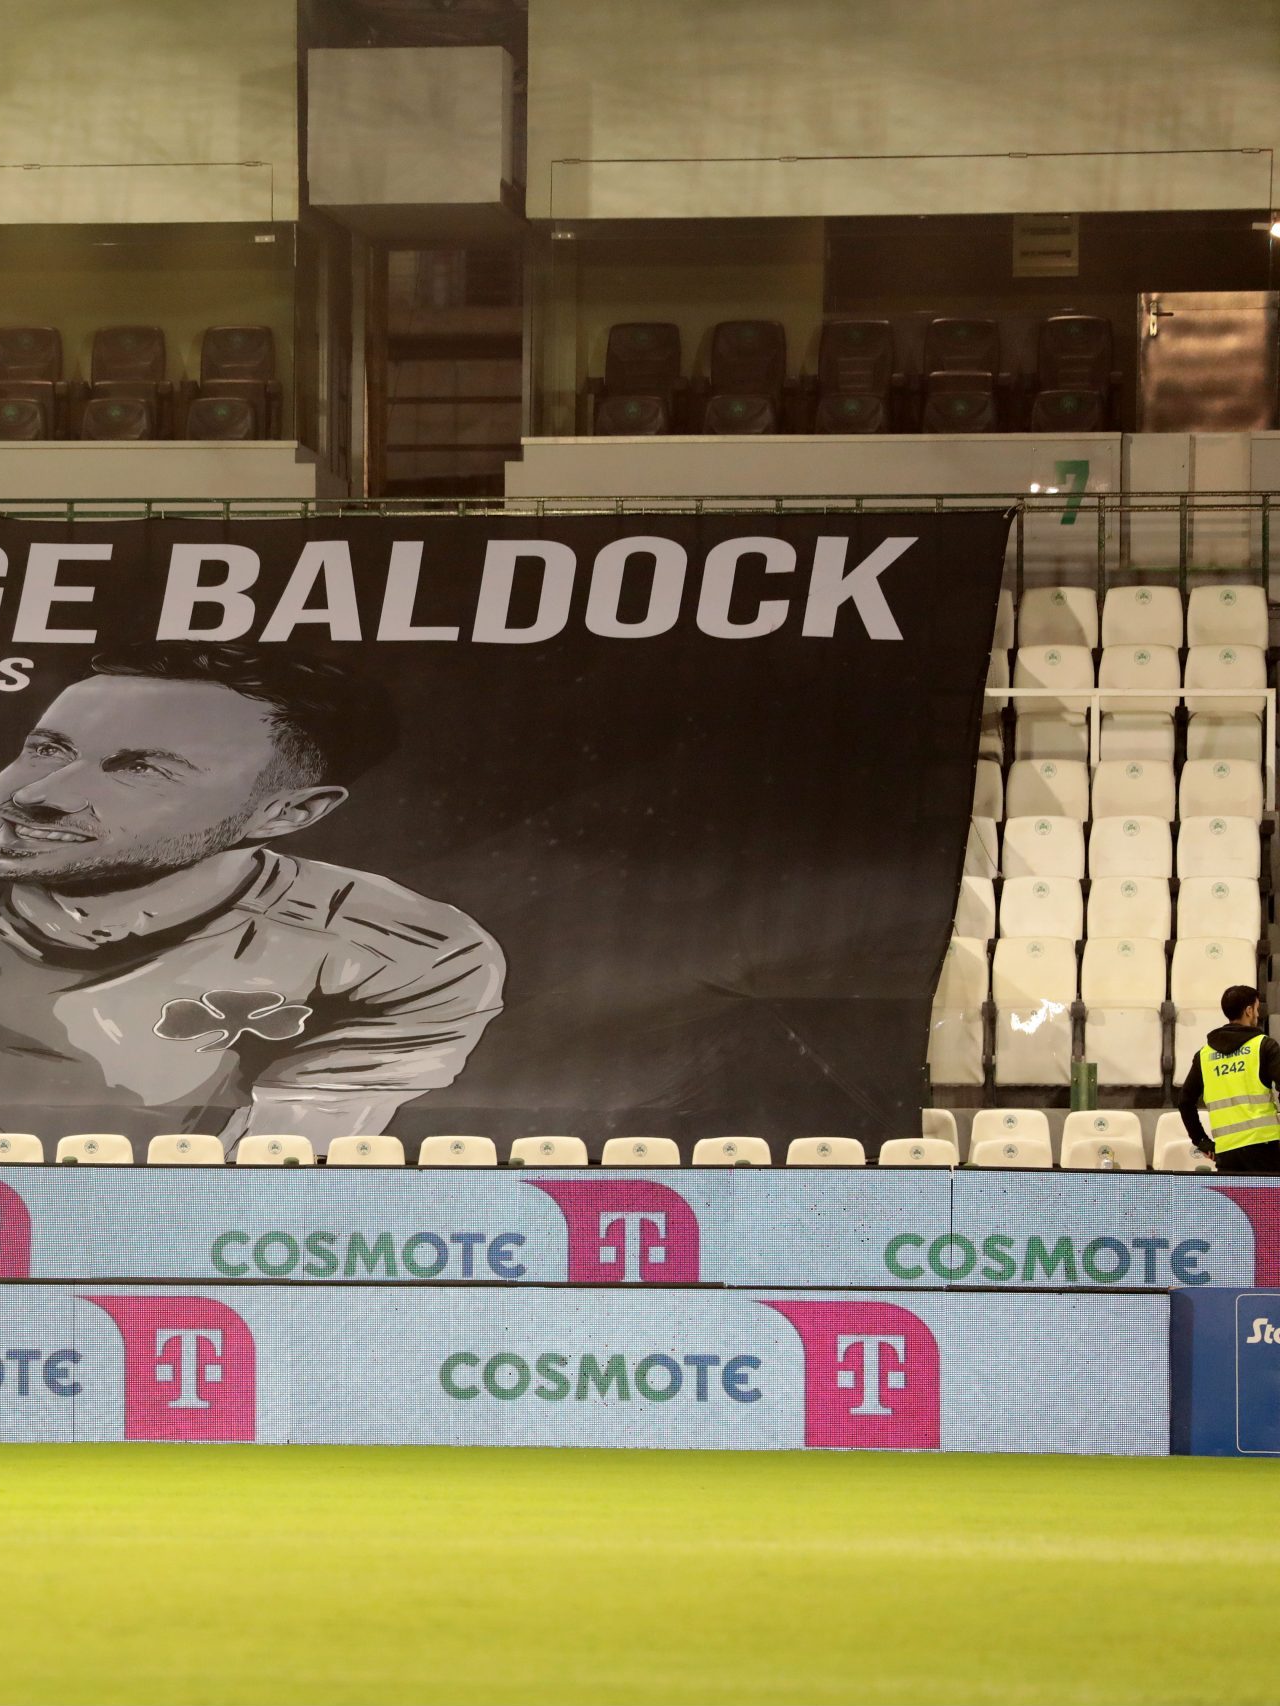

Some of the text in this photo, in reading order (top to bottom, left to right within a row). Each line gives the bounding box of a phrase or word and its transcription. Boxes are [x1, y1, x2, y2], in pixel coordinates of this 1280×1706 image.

[1055, 461, 1089, 525] 7
[155, 536, 919, 644] BALDOCK
[1213, 1060, 1245, 1077] 1242
[211, 1231, 526, 1280] COSMOTE
[885, 1233, 1210, 1284] COSMOTE
[440, 1352, 762, 1405] COSMOTE
